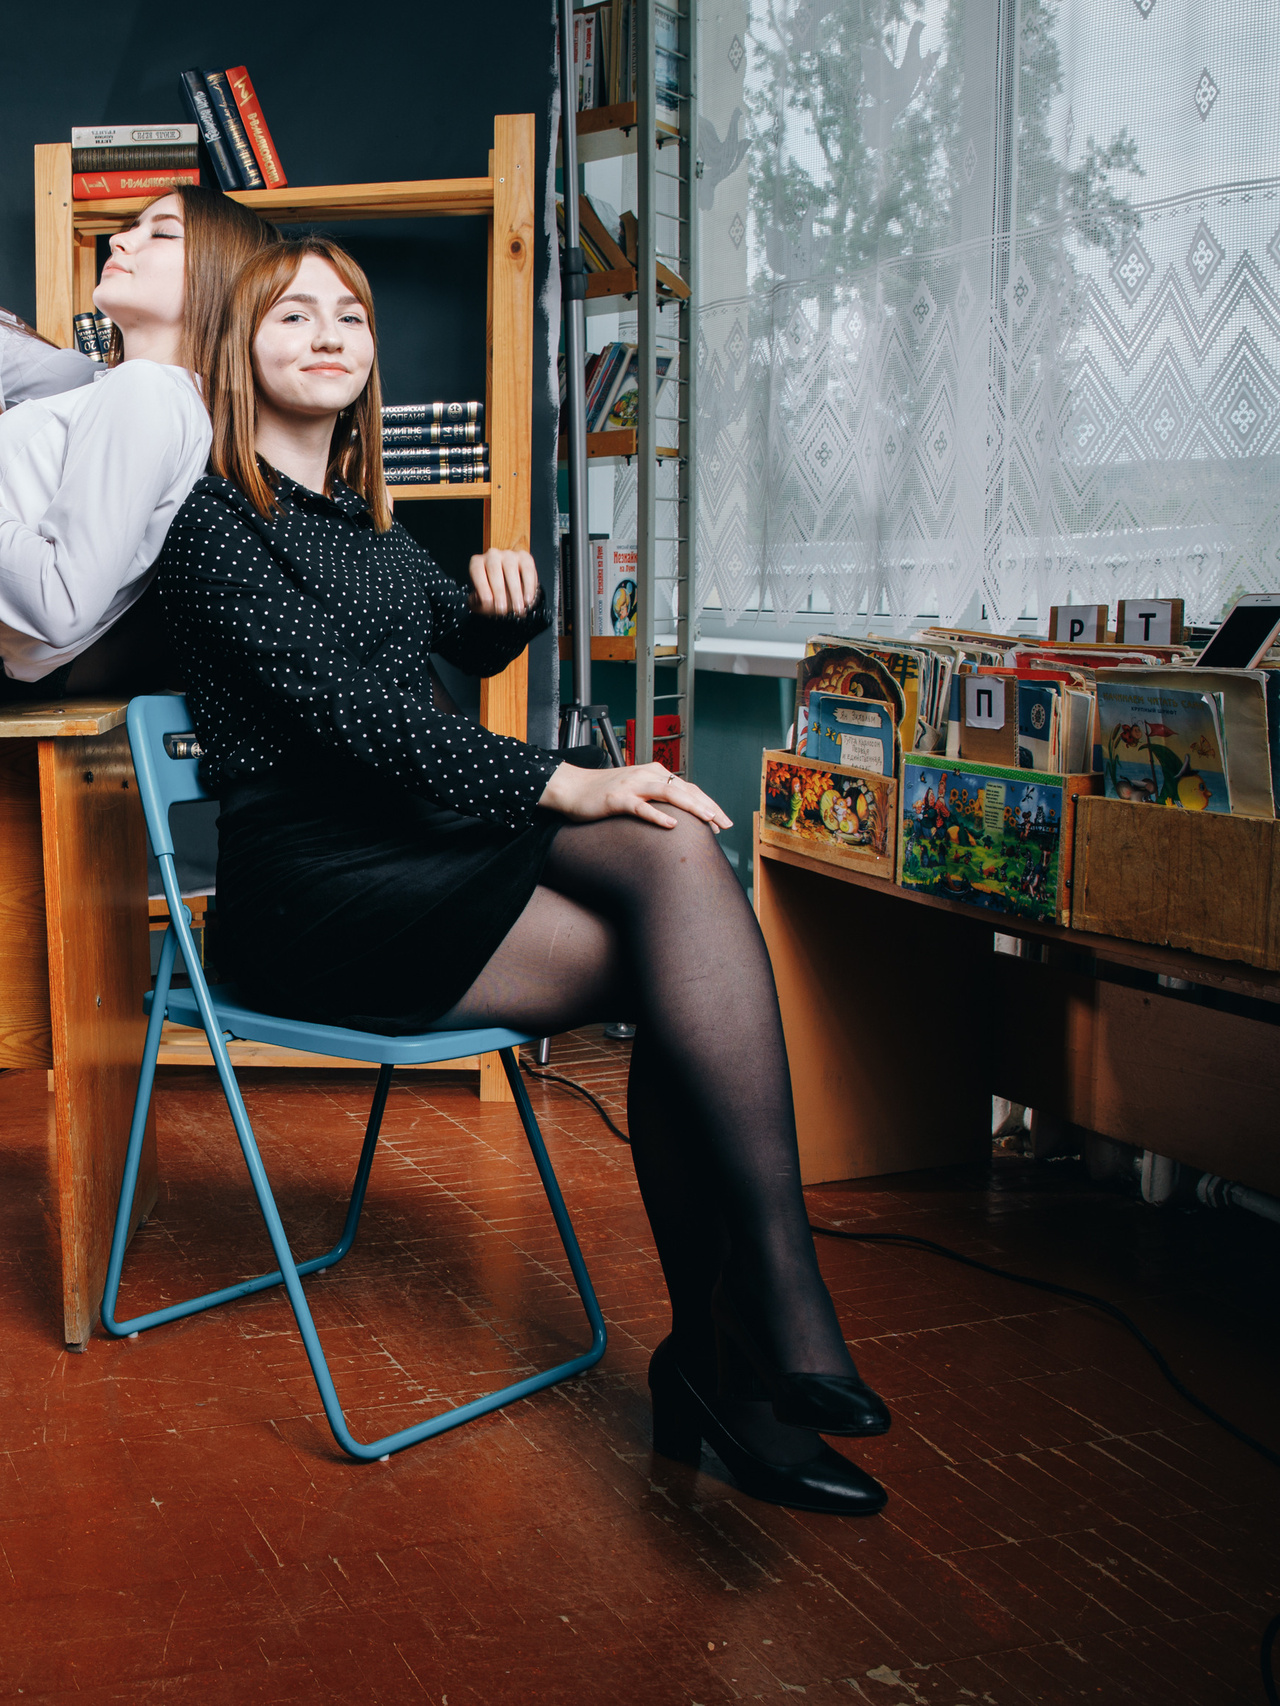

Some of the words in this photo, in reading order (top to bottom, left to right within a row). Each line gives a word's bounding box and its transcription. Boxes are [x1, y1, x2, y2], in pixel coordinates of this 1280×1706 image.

[382, 413, 426, 422] КЛОПЕДИЯ
[596, 545, 604, 559] Луне
[613, 551, 638, 564] Незнайк
[596, 569, 604, 595] Незнайка
[1138, 613, 1157, 641] Т
[976, 688, 993, 718] П
[1103, 692, 1144, 704] НАЧИНАЕМ
[1147, 697, 1178, 708] ЧИТАТЬ
[1131, 706, 1157, 714] КРУПНЫЙ
